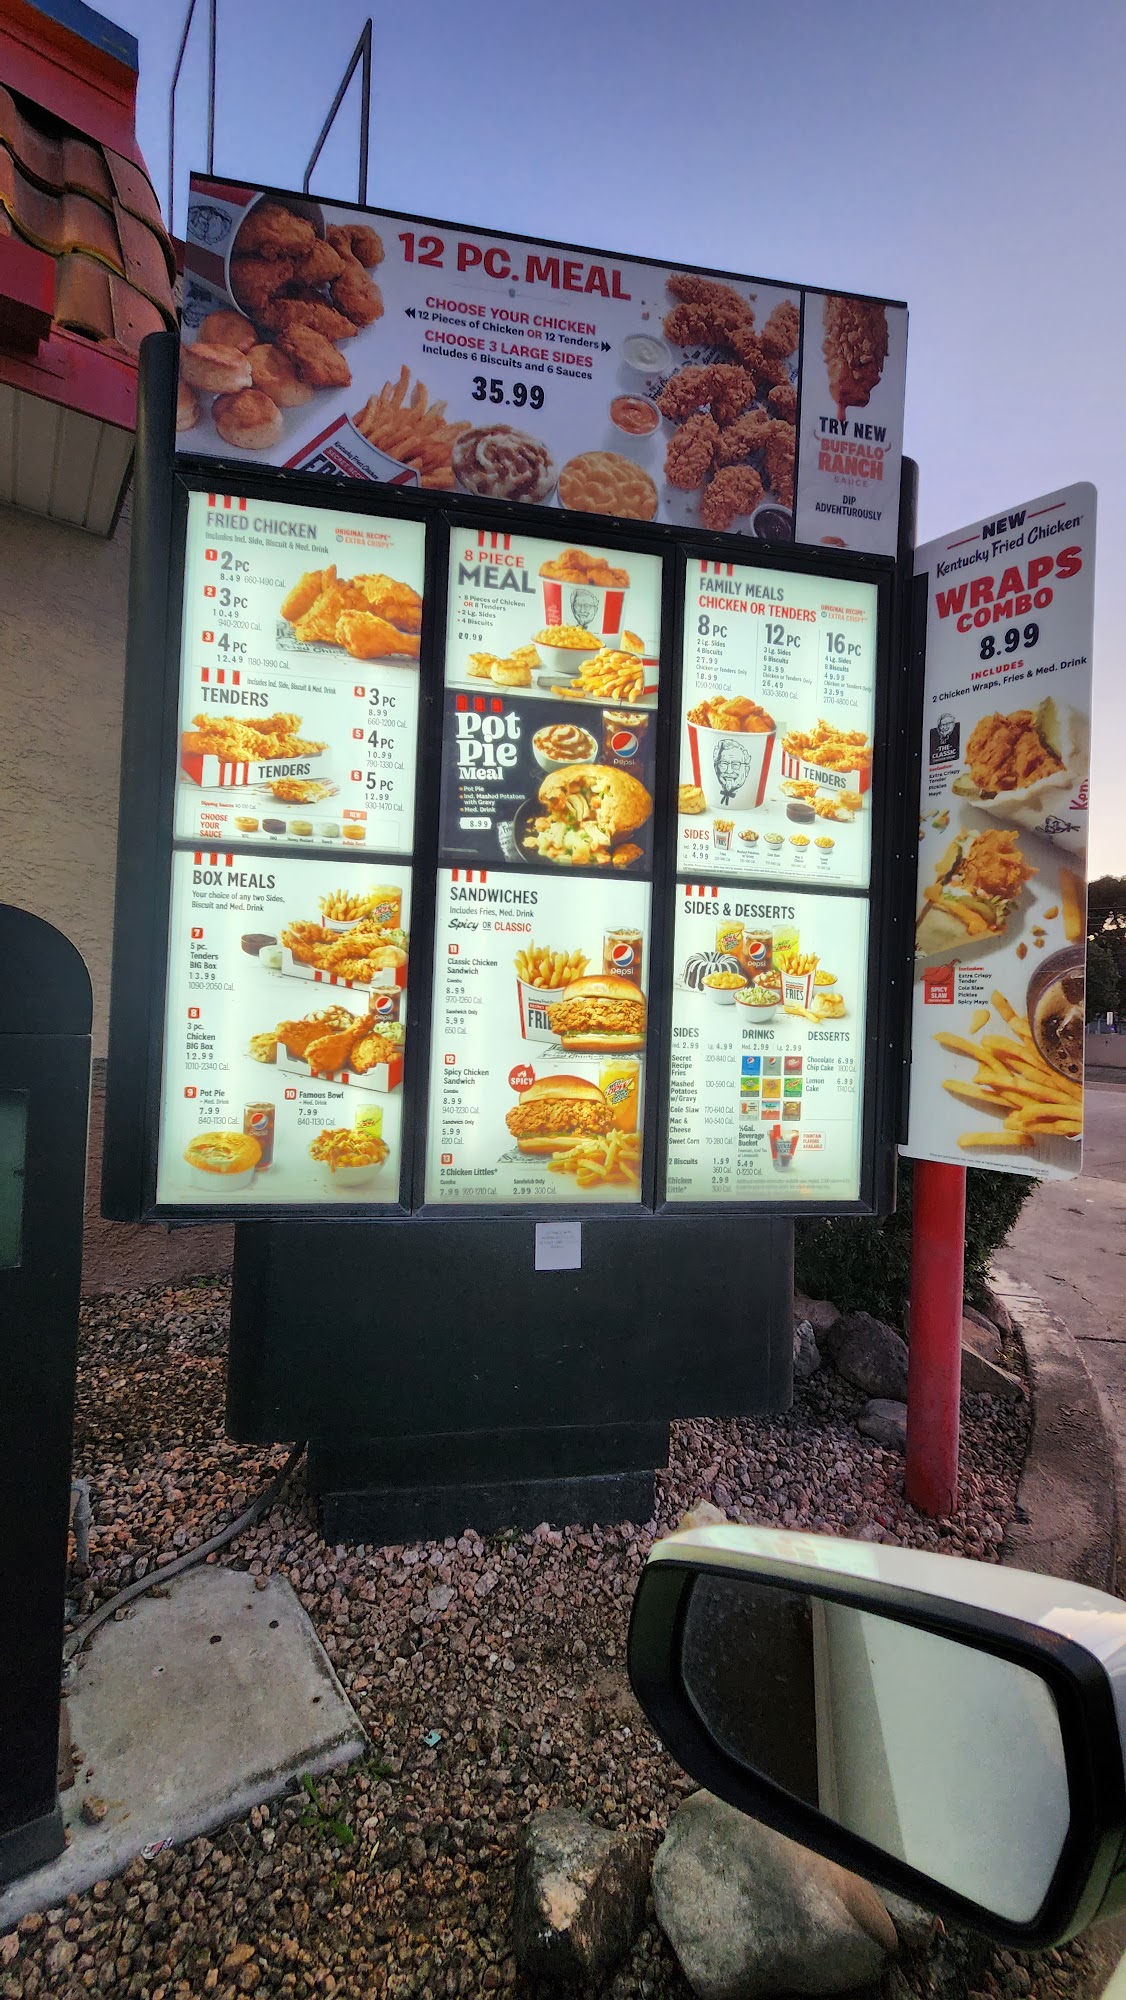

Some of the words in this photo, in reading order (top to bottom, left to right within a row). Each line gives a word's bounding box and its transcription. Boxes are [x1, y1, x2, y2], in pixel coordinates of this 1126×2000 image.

[398, 232, 445, 268] 12
[426, 297, 486, 317] CHOOSE
[490, 307, 529, 325] YOUR
[533, 315, 596, 336] CHICKEN
[418, 310, 428, 321] 12
[432, 313, 466, 328] Pieces
[469, 320, 479, 329] of
[482, 322, 524, 336] Chicken
[527, 329, 542, 339] OR
[545, 332, 555, 341] 12
[558, 334, 599, 349] Tenders
[425, 330, 485, 350] CHOOSE
[489, 341, 497, 351] 3
[501, 342, 548, 361] LARGE
[553, 351, 593, 367] SIDES
[423, 344, 468, 361] Includes
[471, 352, 477, 361] 6
[480, 354, 522, 370] Biscuits
[525, 359, 544, 372] and
[547, 364, 553, 374] 6
[556, 366, 592, 380] Sauces
[471, 375, 545, 410] 35.99
[819, 417, 848, 436] TRY
[854, 422, 887, 442] NEW
[820, 439, 884, 459] BUFFALO
[818, 452, 883, 480] RANCH
[834, 475, 868, 488] SAUCE
[843, 495, 856, 504] DIP
[815, 503, 882, 521] ADVENTUROUSLY
[207, 512, 248, 530] FRIED
[254, 517, 317, 540] CHICKEN
[982, 510, 1026, 540] NEW
[221, 551, 233, 570] 2
[235, 560, 249, 572] PC
[465, 550, 473, 561] 8
[479, 552, 525, 568] PIECE
[936, 549, 989, 578] Kentucky
[991, 533, 1024, 557] Fried
[220, 573, 240, 582] 8.49
[458, 562, 536, 594] MEAL
[936, 546, 1082, 619] WRAPS
[220, 588, 230, 606] 3
[234, 597, 248, 608] PC
[700, 577, 742, 595] FAMILY
[745, 584, 784, 602] MEALS
[699, 595, 747, 612] CHICKEN
[750, 603, 765, 615] OR
[769, 604, 816, 622] TENDERS
[957, 587, 1053, 633] COMBO
[698, 614, 710, 635] 8
[713, 625, 727, 638] PC
[765, 624, 784, 646] 12
[787, 635, 801, 648] PC
[218, 633, 230, 651] 4
[233, 642, 247, 653] PC
[827, 632, 845, 654] 16
[848, 643, 861, 656] PC
[979, 623, 1039, 660] 8.99
[939, 687, 970, 701] Chicken
[972, 677, 1000, 692] Wraps,
[1003, 673, 1024, 684] Fries
[1036, 663, 1058, 676] Med.
[1061, 656, 1087, 669] Drink
[971, 660, 1024, 680] INCLUDES
[201, 687, 269, 707] TENDERS
[369, 688, 379, 705] 3
[382, 696, 396, 707] PC
[455, 712, 520, 740] Pot
[368, 730, 379, 748] 4
[381, 738, 394, 749] PC
[456, 734, 517, 767] Pie
[932, 749, 956, 759] CLASSIC
[258, 763, 310, 778] TENDERS
[459, 767, 504, 780] Meal
[804, 767, 846, 788] TENDERS
[366, 772, 376, 789] 5
[380, 780, 393, 791] PC
[201, 813, 228, 821] CHOOSE
[200, 830, 222, 838] SAUCE
[684, 829, 710, 840] SIDES
[193, 870, 222, 885] BOX
[228, 872, 275, 889] MEALS
[192, 890, 207, 898] Your
[209, 891, 230, 899] choice
[266, 895, 285, 903] Sides,
[192, 901, 214, 909] Biscuit
[450, 887, 538, 904] SANDWICHES
[450, 906, 477, 914] Includes
[480, 908, 497, 916] Fries,
[685, 901, 719, 915] SIDES
[723, 904, 731, 916] &
[735, 904, 795, 919] DESSERTS
[448, 919, 479, 931] Spicy
[494, 922, 531, 932] CLASSIC
[191, 952, 218, 960] Tenders
[786, 989, 803, 1000] FRIES
[673, 1028, 699, 1037] SIDES
[742, 1030, 774, 1039] DRINKS
[808, 1031, 850, 1041] DESSERTS
